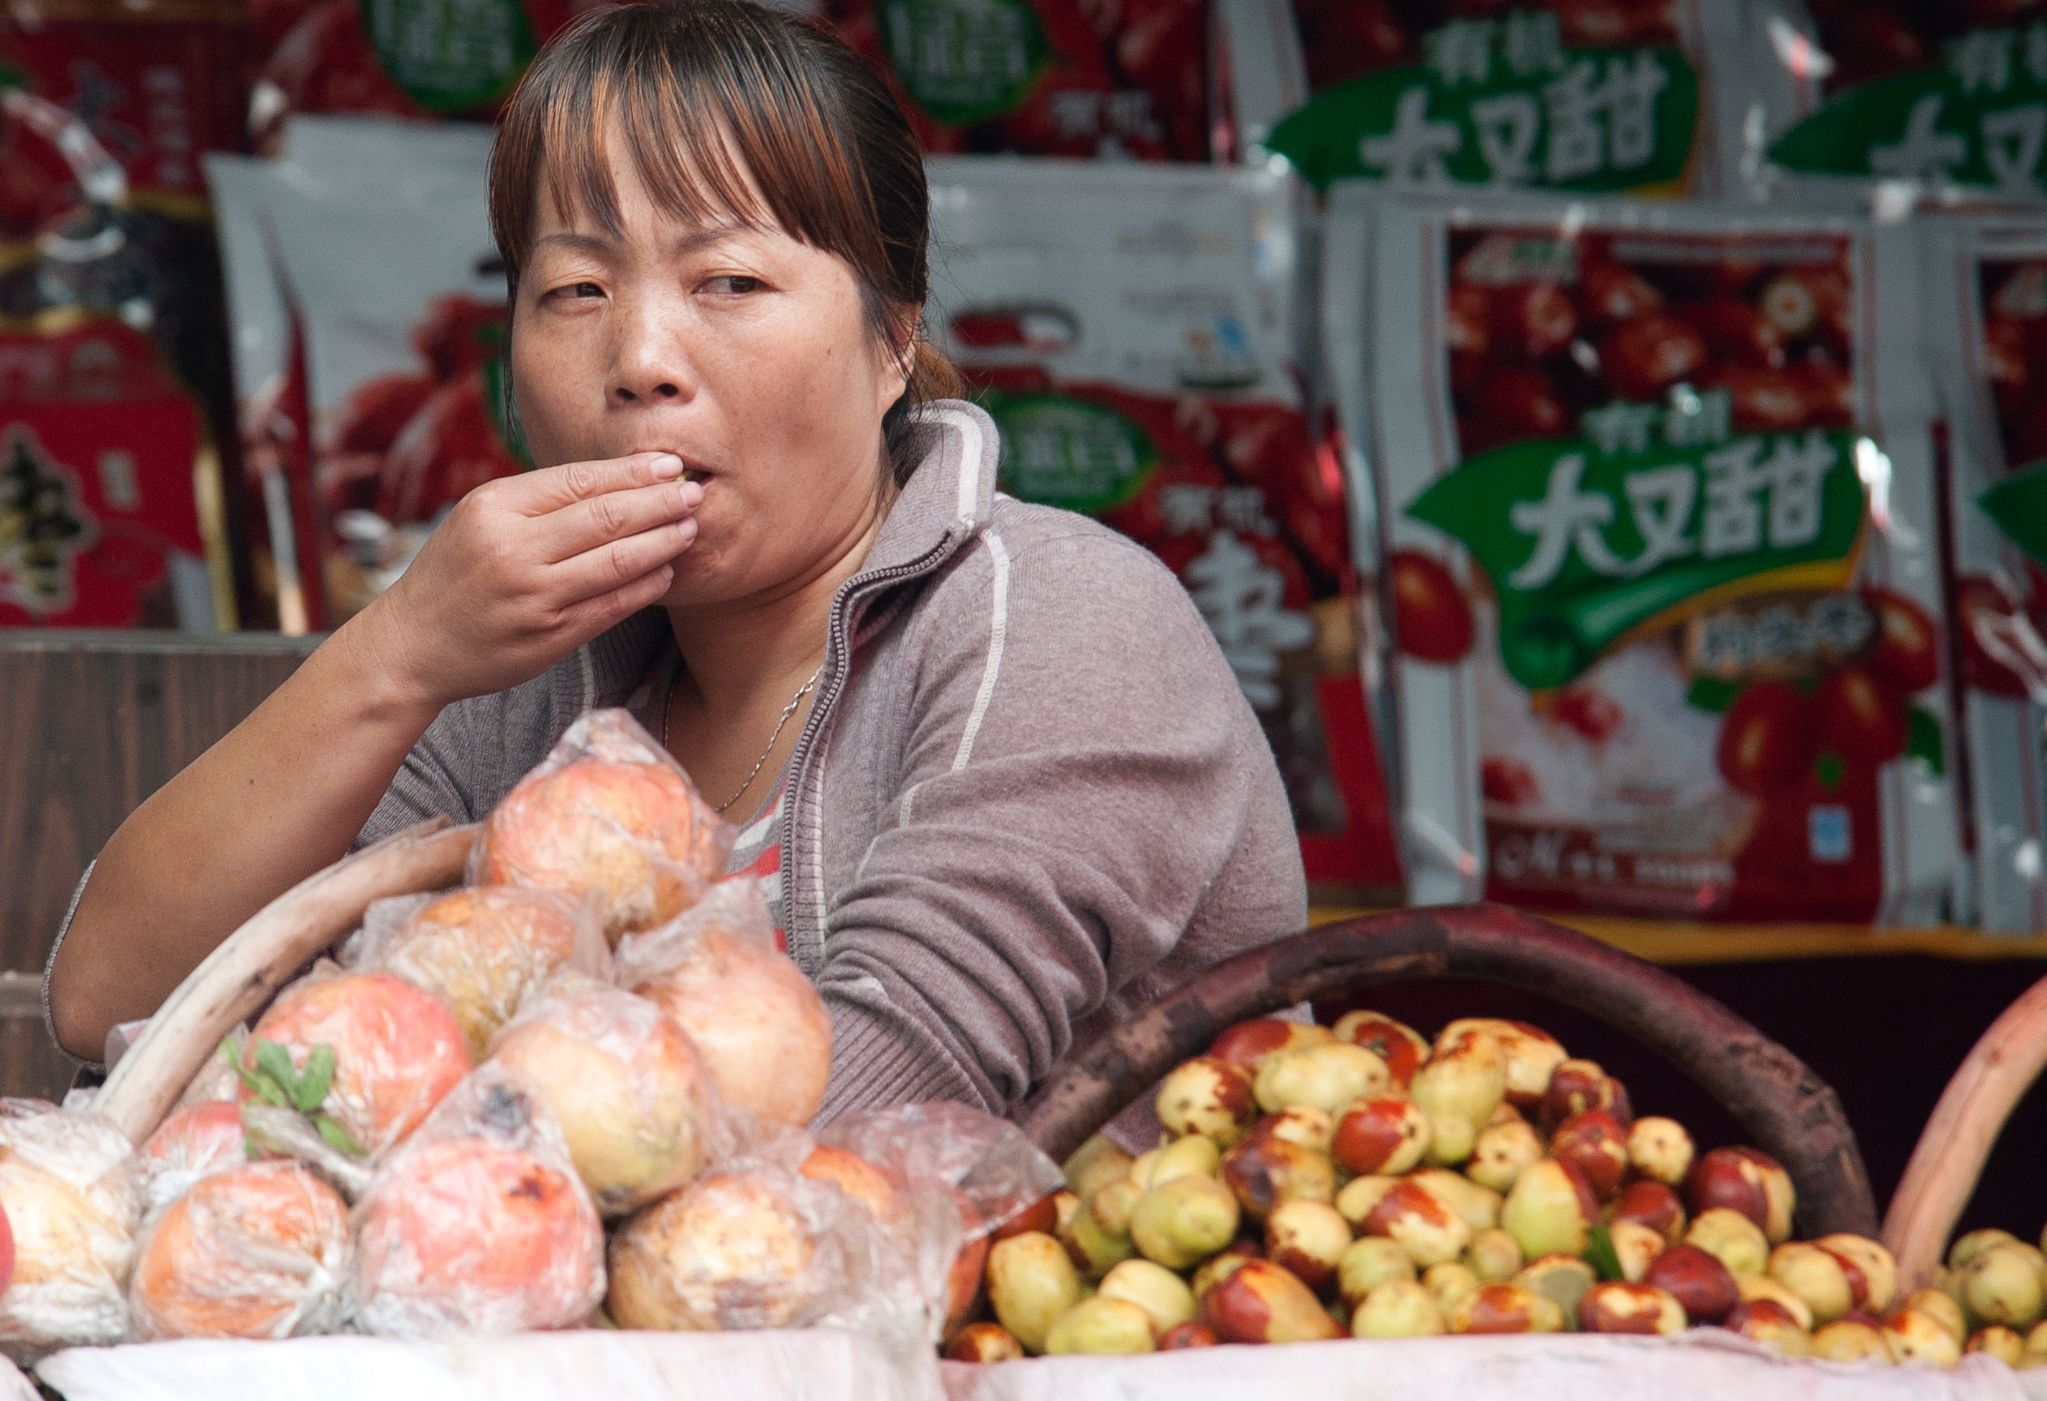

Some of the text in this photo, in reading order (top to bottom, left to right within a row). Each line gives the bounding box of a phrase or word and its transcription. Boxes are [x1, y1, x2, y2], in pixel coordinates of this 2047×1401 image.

[1360, 50, 1670, 190] 大又甜
[1508, 430, 1836, 590] 大又甜
